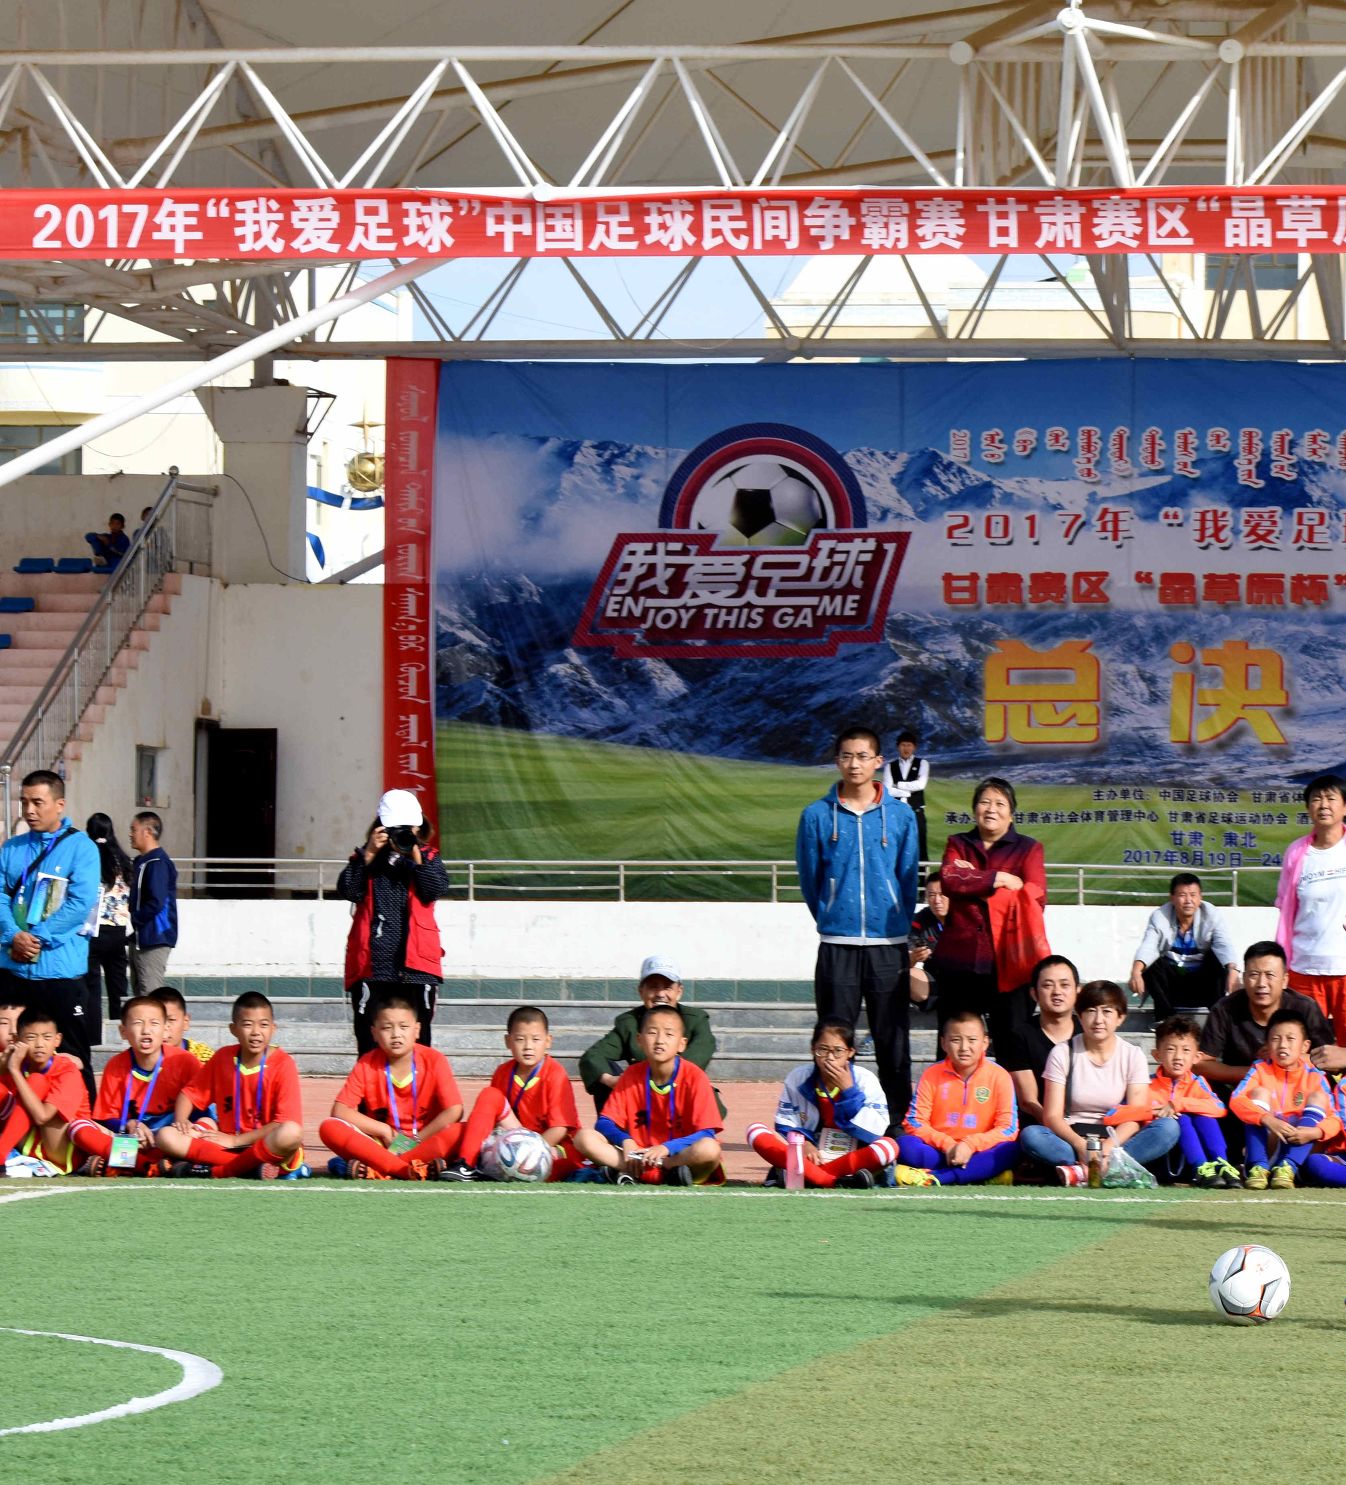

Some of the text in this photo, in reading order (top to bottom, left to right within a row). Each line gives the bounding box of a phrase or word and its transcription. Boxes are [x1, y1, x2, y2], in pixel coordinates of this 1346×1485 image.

[611, 537, 877, 608] 我爱足球
[605, 595, 861, 630] ENJOY THIS GAME
